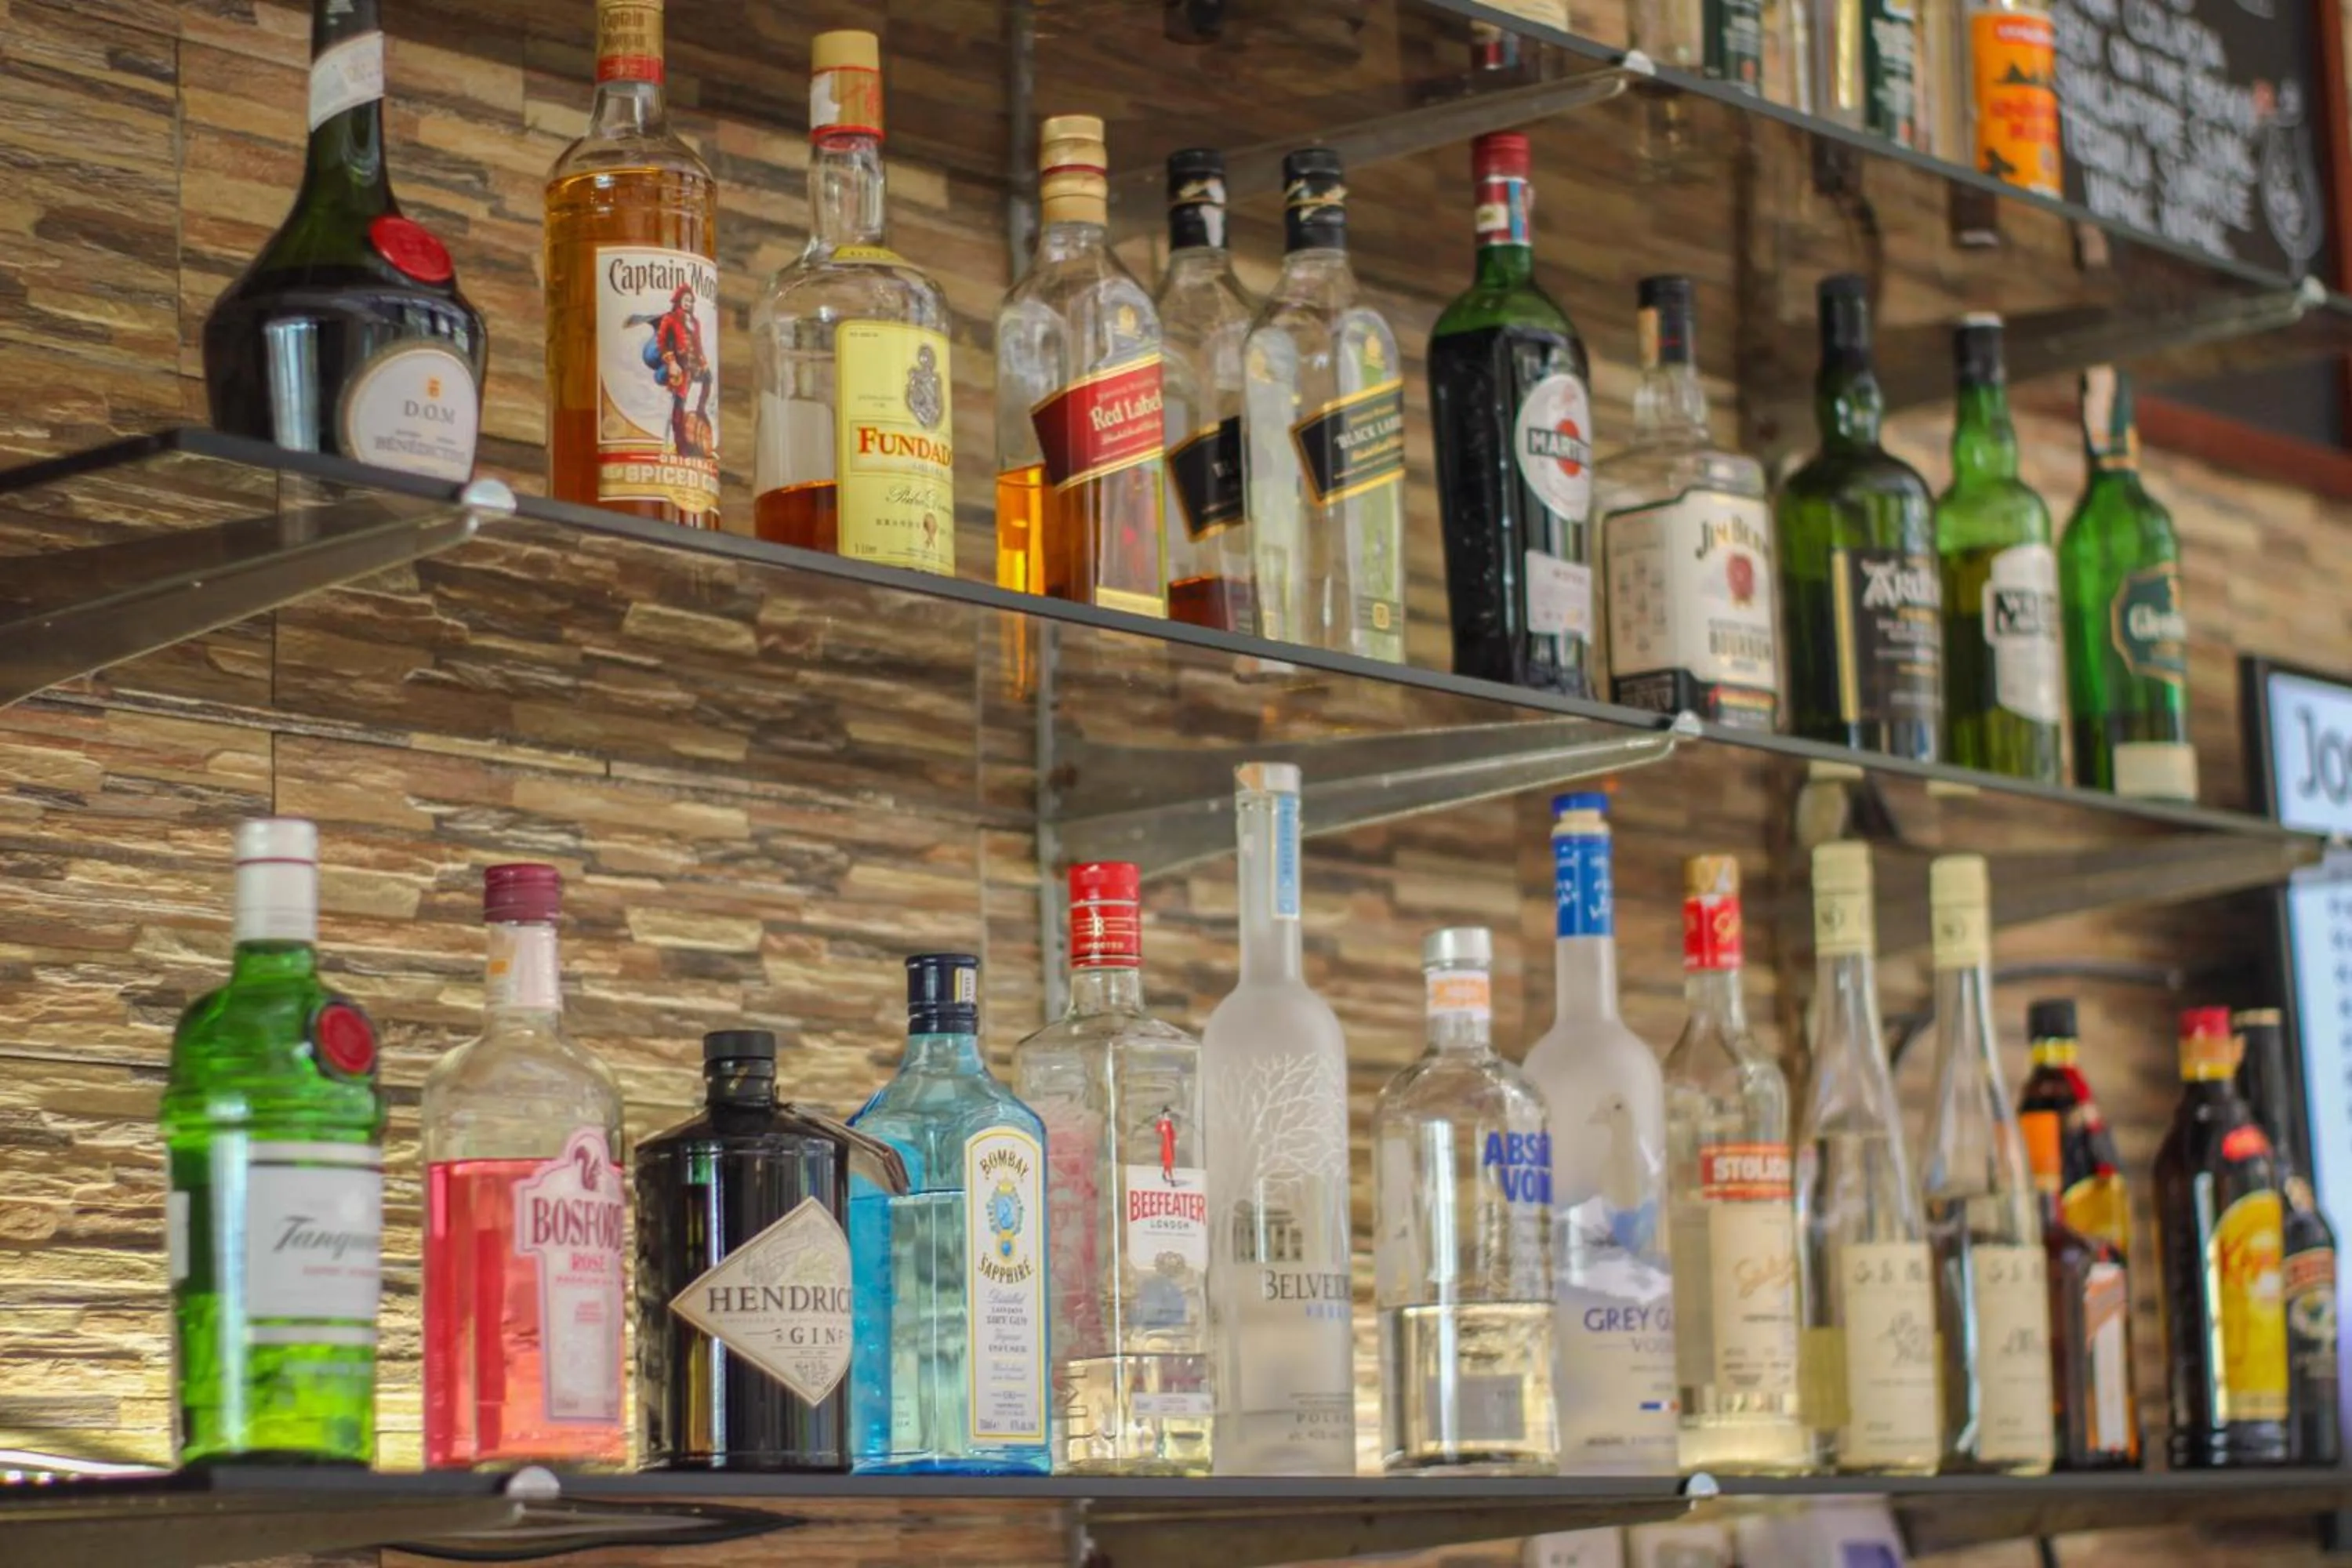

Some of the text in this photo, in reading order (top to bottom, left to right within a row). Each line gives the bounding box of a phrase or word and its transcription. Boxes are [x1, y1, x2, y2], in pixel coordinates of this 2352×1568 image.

[609, 258, 685, 296] Captain
[1089, 400, 1124, 432] Red
[980, 1149, 1030, 1178] BOMBAY
[1129, 1189, 1206, 1227] BEEFEATER
[1149, 1219, 1190, 1230] LONDON
[979, 1252, 1034, 1284] SAPPHIRE
[1584, 1306, 1650, 1332] GREY
[789, 1327, 844, 1345] GIN
